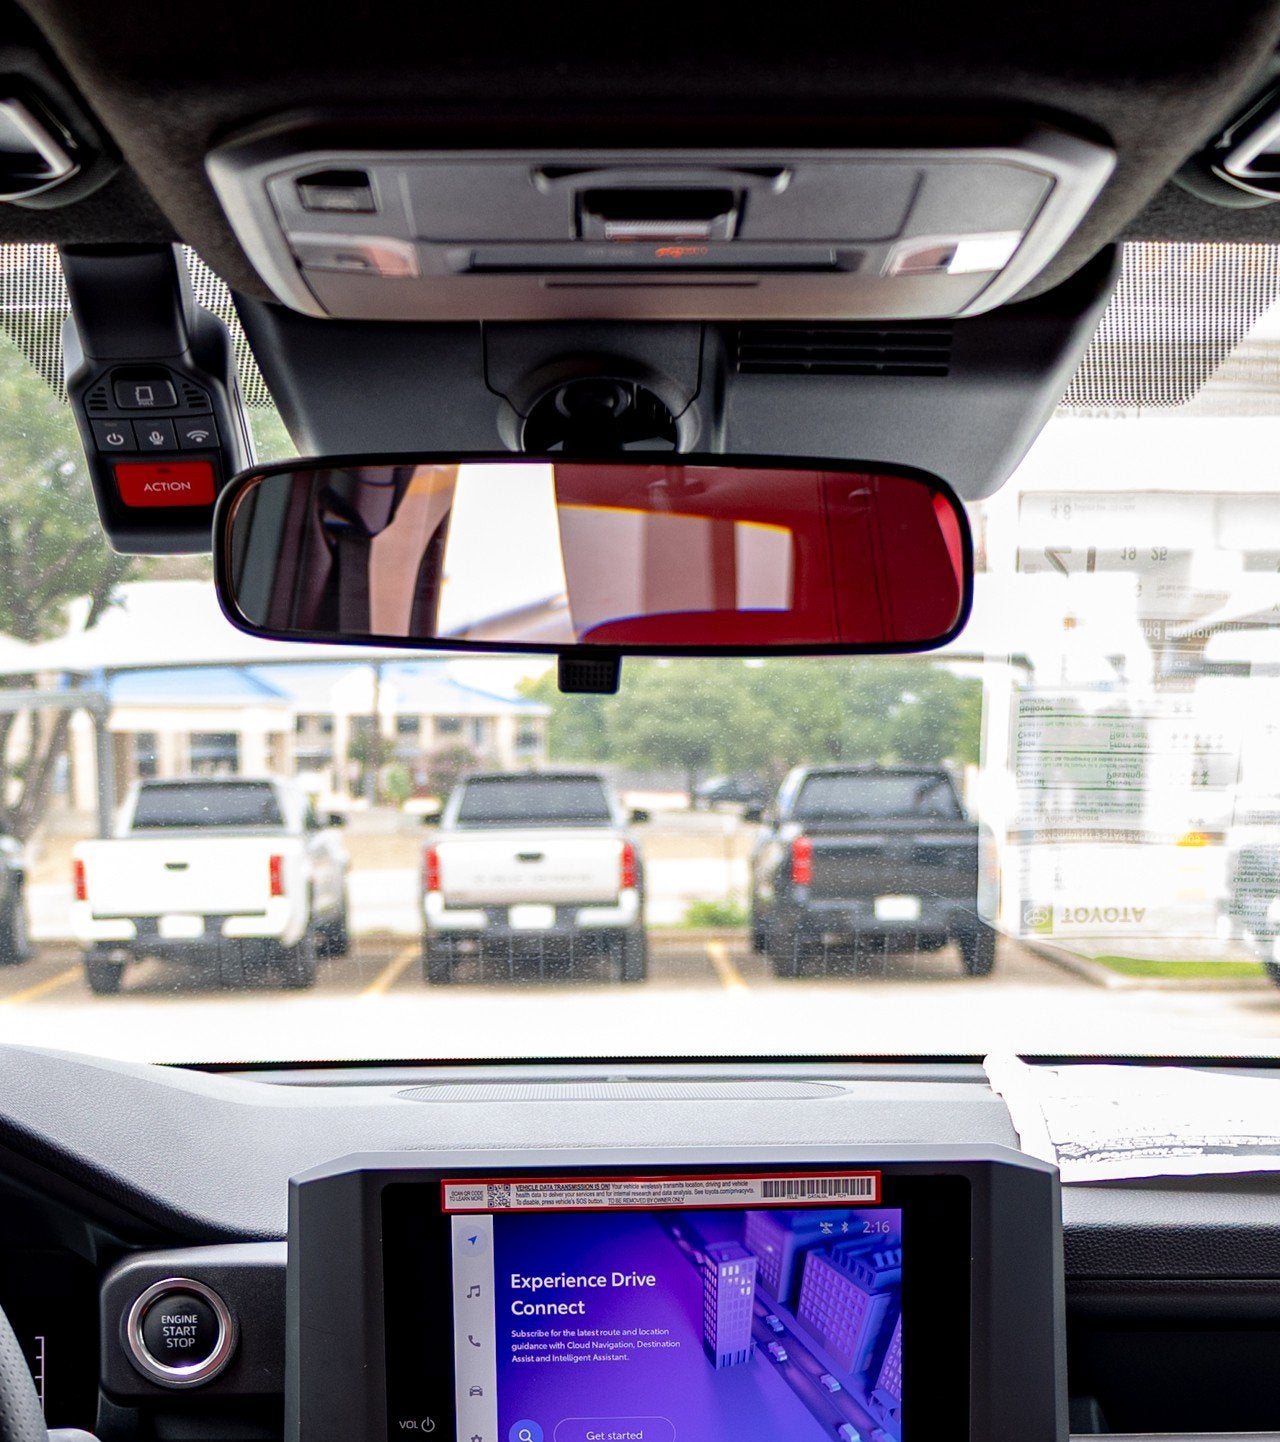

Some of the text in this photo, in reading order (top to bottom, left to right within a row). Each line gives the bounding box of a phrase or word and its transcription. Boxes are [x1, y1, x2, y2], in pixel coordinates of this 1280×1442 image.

[143, 481, 191, 492] ACTION
[862, 1221, 890, 1234] 2:16
[510, 1271, 656, 1292] Experience Drive
[510, 1300, 585, 1316] Connect
[161, 1314, 198, 1324] ENGINE
[163, 1326, 197, 1336] START
[511, 1329, 550, 1337] Subscribe
[551, 1329, 561, 1337] for
[563, 1329, 576, 1337] the
[577, 1329, 599, 1337] latest
[622, 1328, 637, 1336] and
[166, 1338, 196, 1348] STOP
[511, 1340, 680, 1351] guidance with Cloud Navigation, Destination
[399, 1420, 418, 1429] VOL
[586, 1430, 643, 1441] Get started
